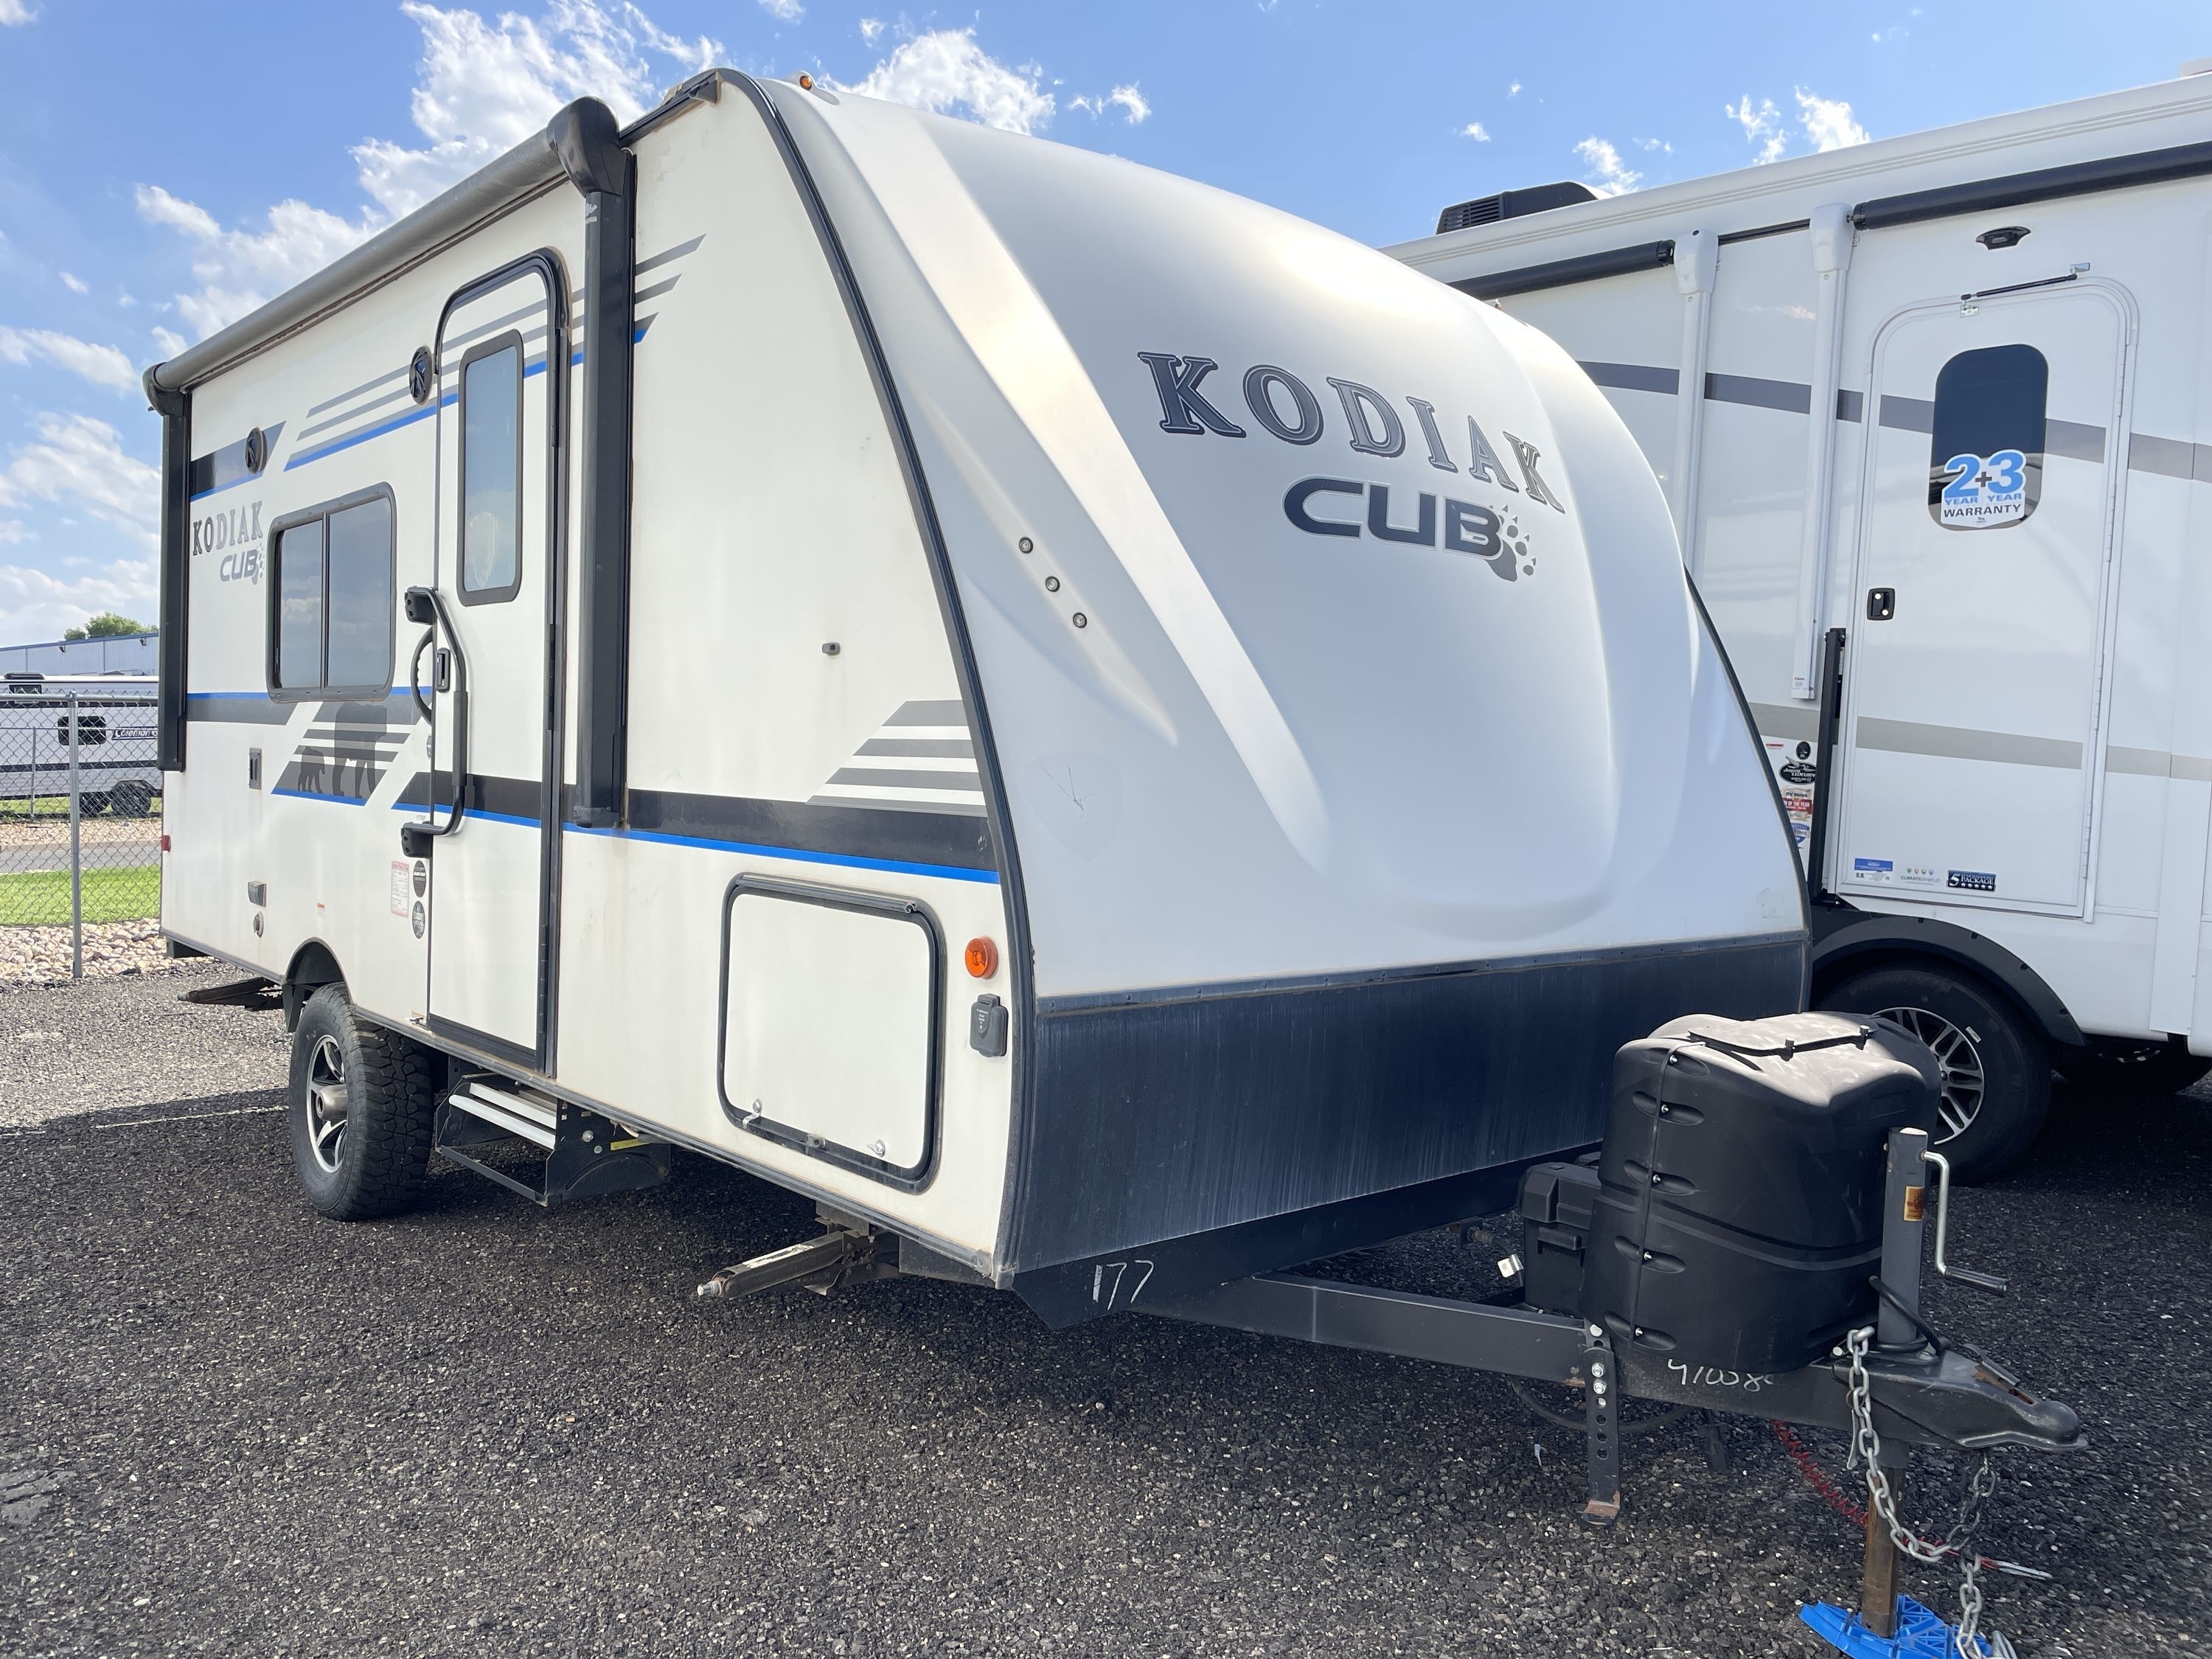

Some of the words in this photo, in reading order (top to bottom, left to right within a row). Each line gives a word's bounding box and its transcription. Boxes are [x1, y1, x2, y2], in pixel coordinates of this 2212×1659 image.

[1137, 351, 1565, 514] KODIAK
[1945, 497, 1978, 506] YEAR
[1987, 493, 2022, 502] YEAR
[1281, 476, 1502, 559] CUB
[1944, 504, 2021, 518] WARRANTY
[192, 501, 263, 556] KODIAK
[220, 549, 258, 582] CUB
[115, 729, 150, 737] Coleman
[1949, 873, 1961, 886] 5
[1961, 876, 1994, 885] PACKAGE
